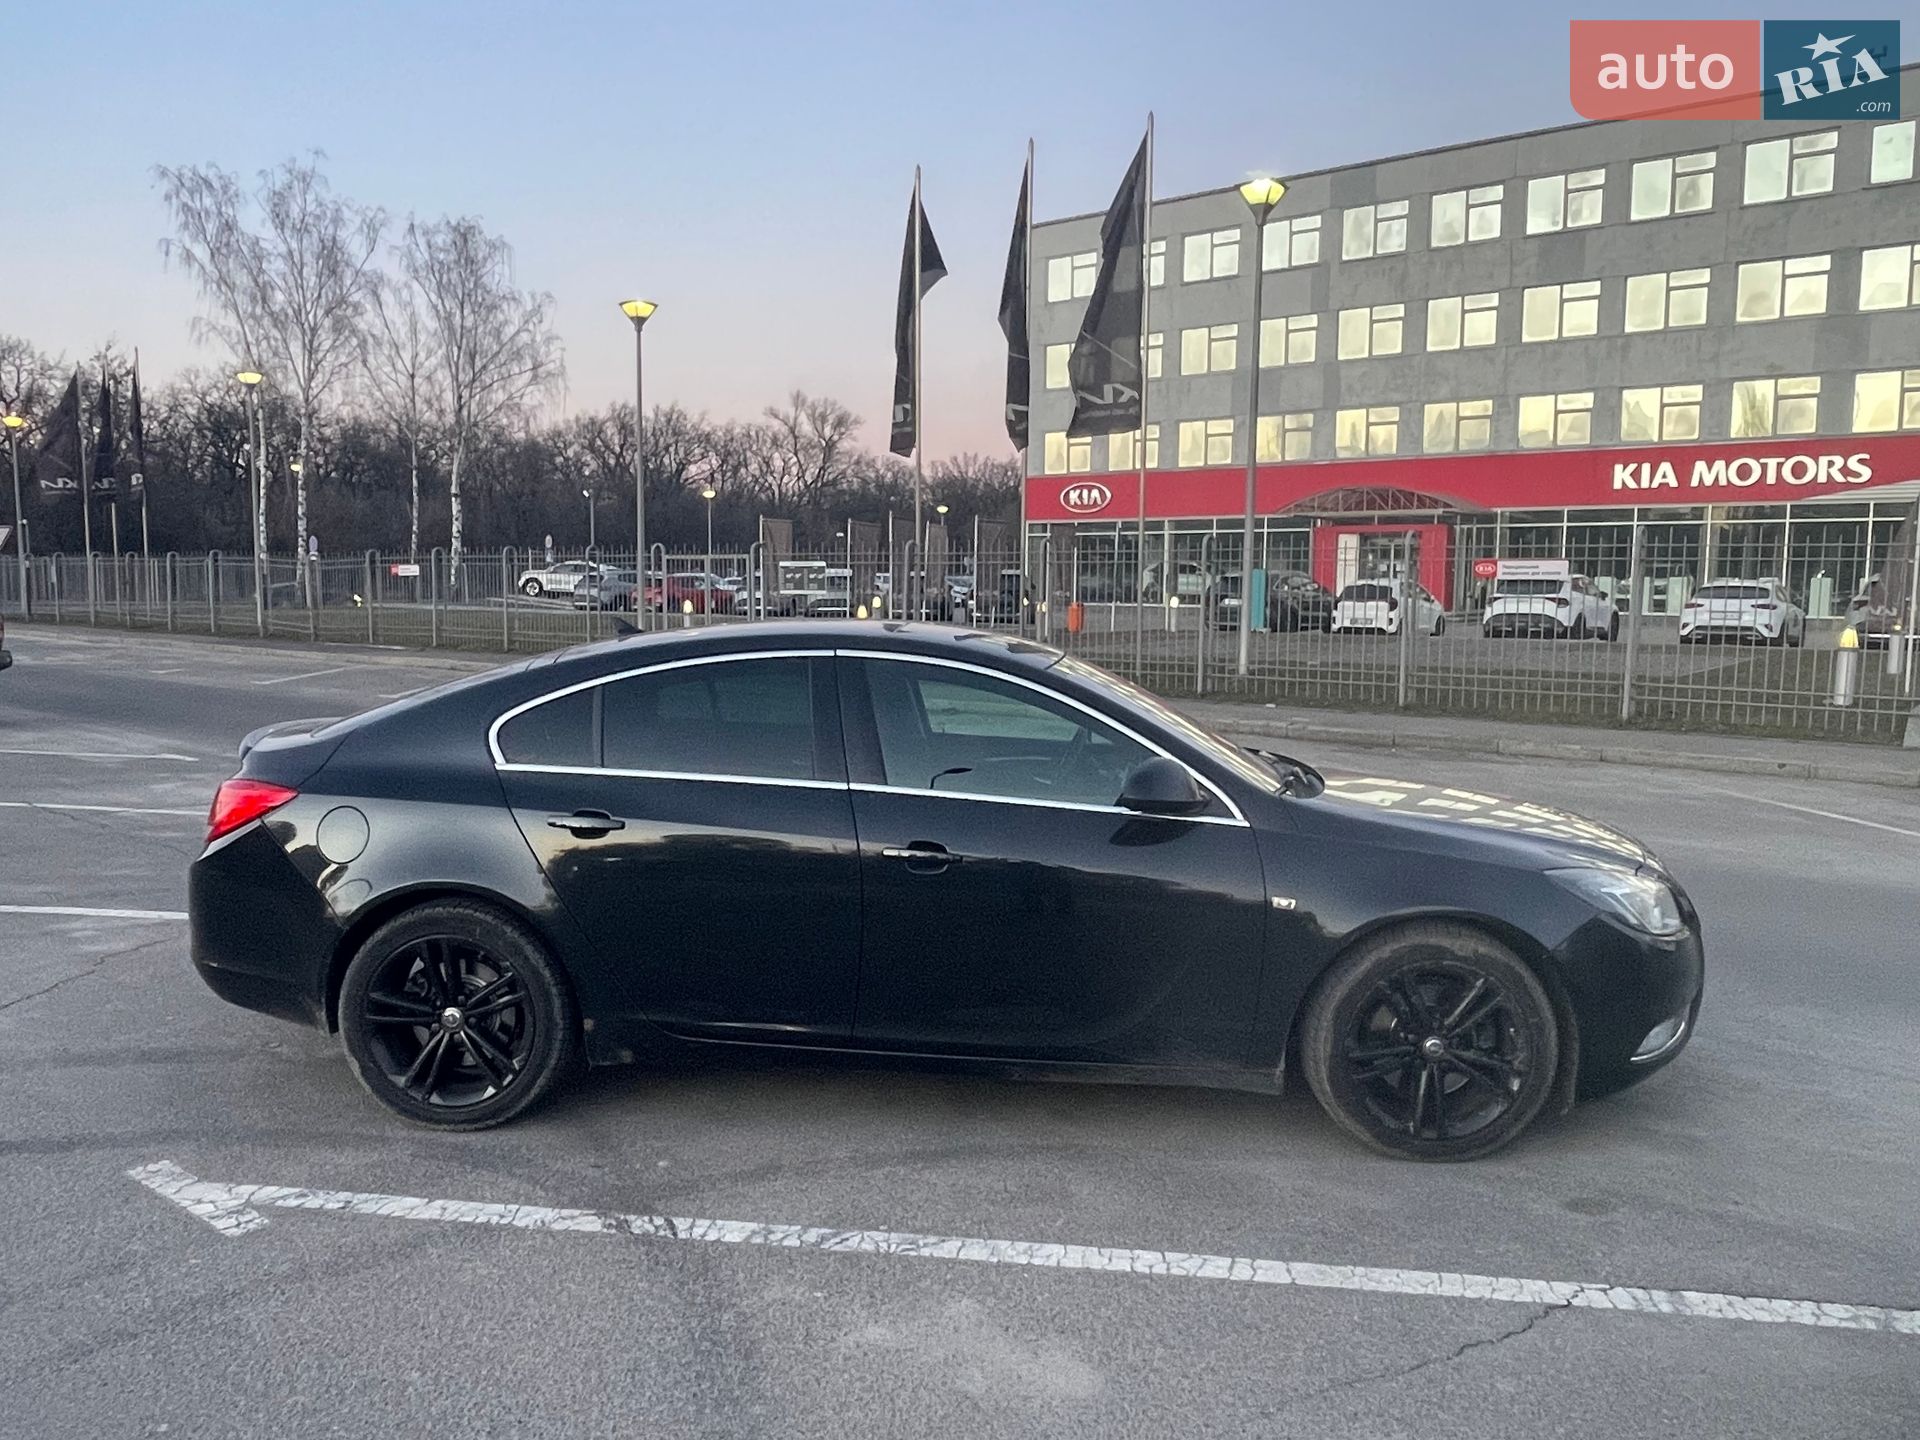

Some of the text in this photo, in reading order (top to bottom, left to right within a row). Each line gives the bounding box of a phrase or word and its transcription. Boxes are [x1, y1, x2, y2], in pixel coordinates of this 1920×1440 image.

[1612, 453, 1873, 490] KIA MOTORS
[1068, 488, 1103, 507] KIA
